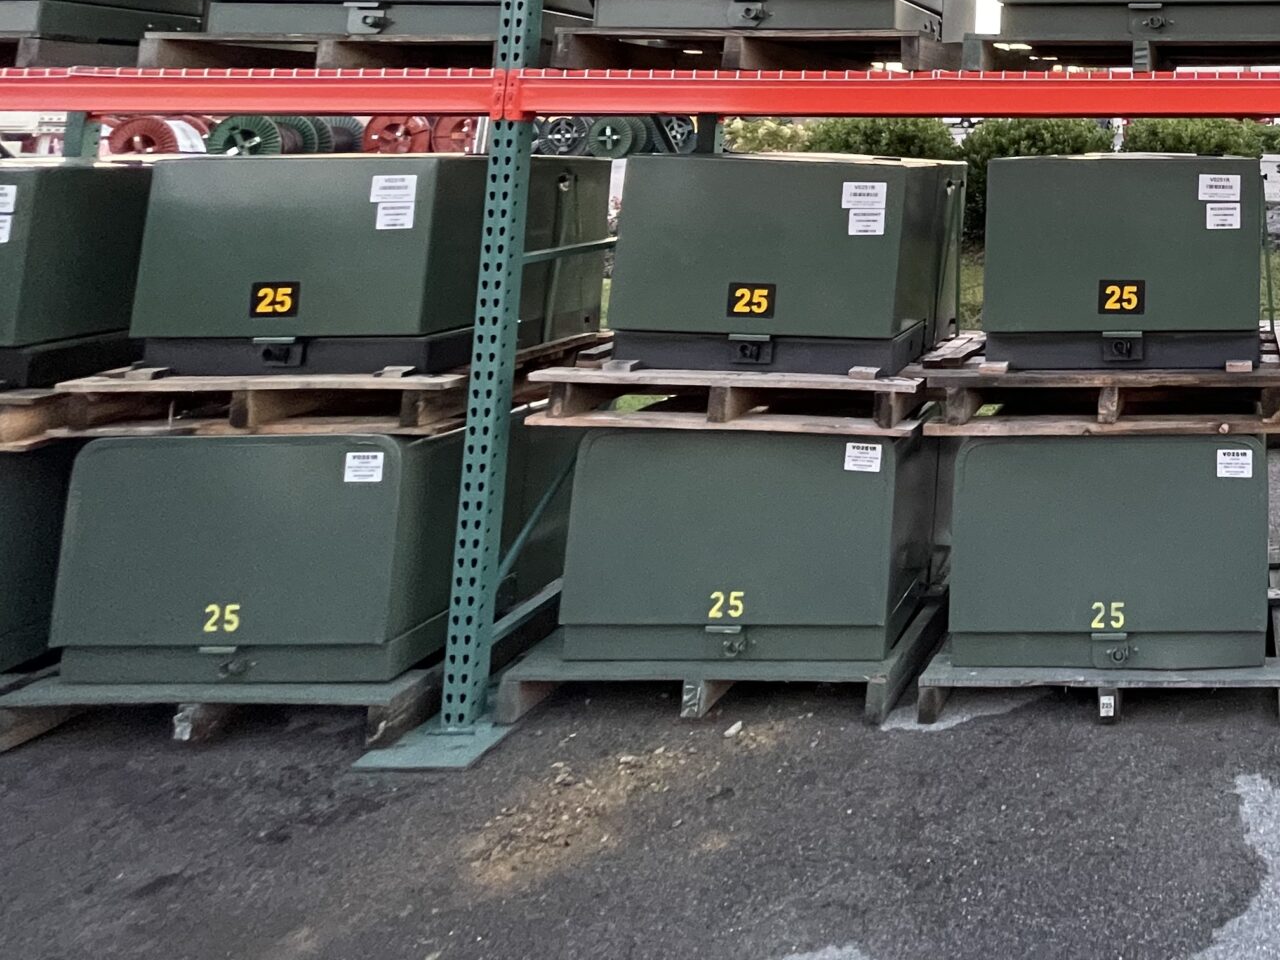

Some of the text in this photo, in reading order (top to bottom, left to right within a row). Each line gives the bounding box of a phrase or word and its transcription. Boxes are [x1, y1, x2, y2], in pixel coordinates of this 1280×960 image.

[256, 287, 292, 312] 25
[734, 288, 768, 313] 25
[1105, 285, 1137, 309] 25
[709, 591, 743, 619] 25
[1091, 603, 1125, 629] 25
[204, 604, 239, 632] 25
